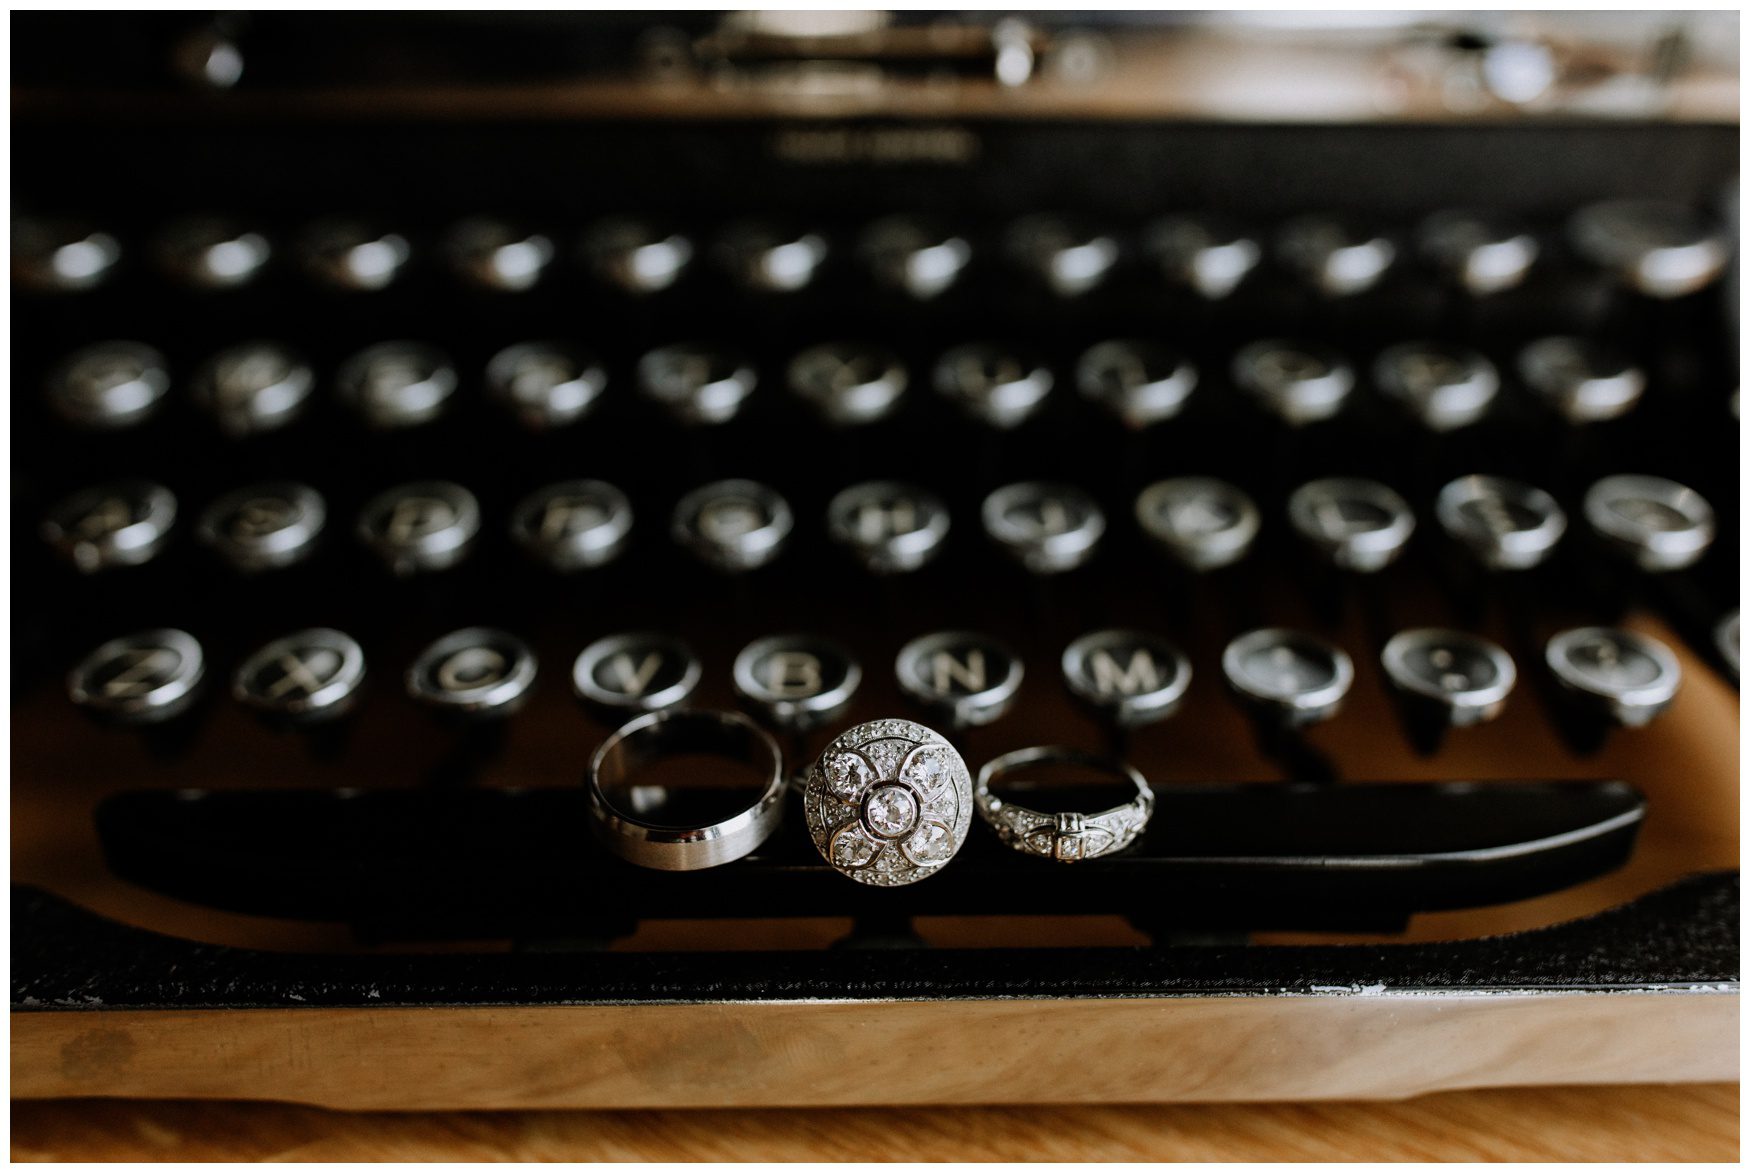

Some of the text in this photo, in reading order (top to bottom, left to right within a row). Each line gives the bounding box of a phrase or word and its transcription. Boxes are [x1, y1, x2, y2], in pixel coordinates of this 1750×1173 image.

[104, 648, 170, 697] Z
[266, 652, 328, 698] X
[437, 647, 506, 691] C
[612, 650, 663, 694] V
[771, 650, 823, 694] B
[932, 647, 986, 694] N
[1091, 647, 1158, 693] M
